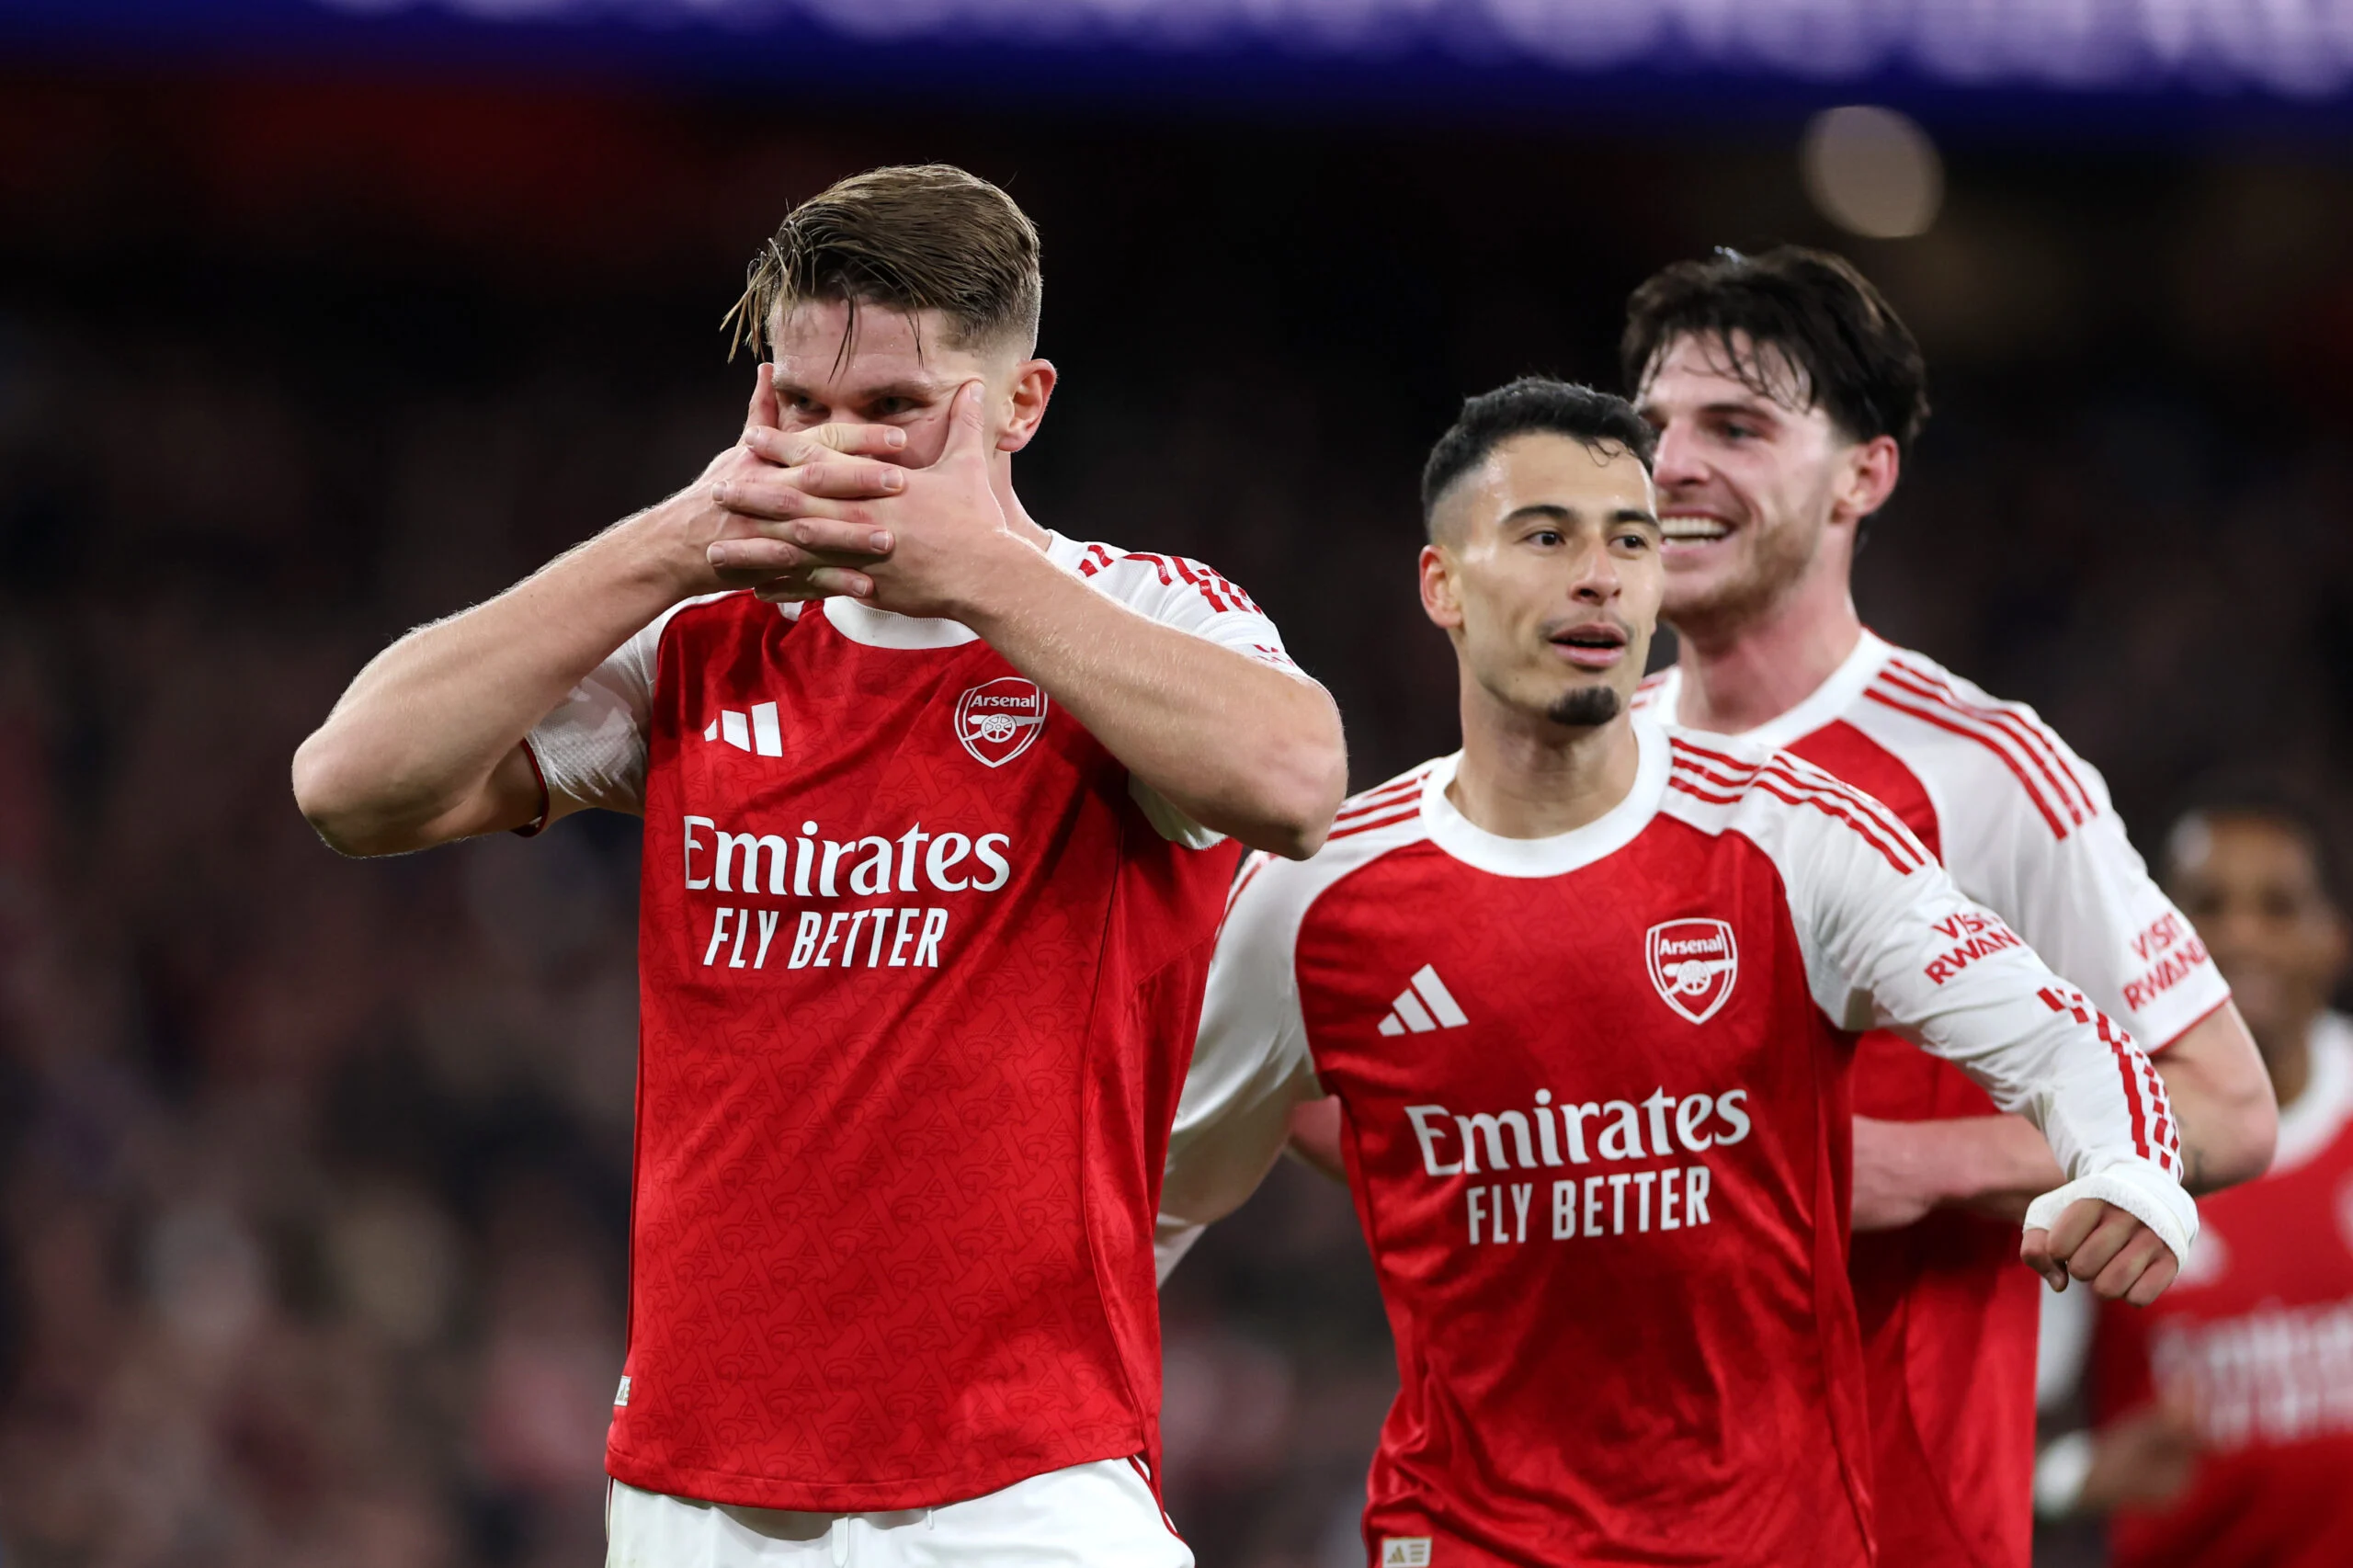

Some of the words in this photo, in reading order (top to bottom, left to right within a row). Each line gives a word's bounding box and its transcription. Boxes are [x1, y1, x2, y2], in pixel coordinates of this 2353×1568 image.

[970, 694, 1036, 708] Arsenal
[683, 814, 1010, 897] Emirates
[702, 907, 779, 970] FLY
[787, 907, 949, 970] BETTER
[1659, 934, 1724, 956] Arsenal
[1404, 1085, 1751, 1176] Emirates
[1466, 1182, 1533, 1244] FLY
[1552, 1165, 1711, 1241] BETTER
